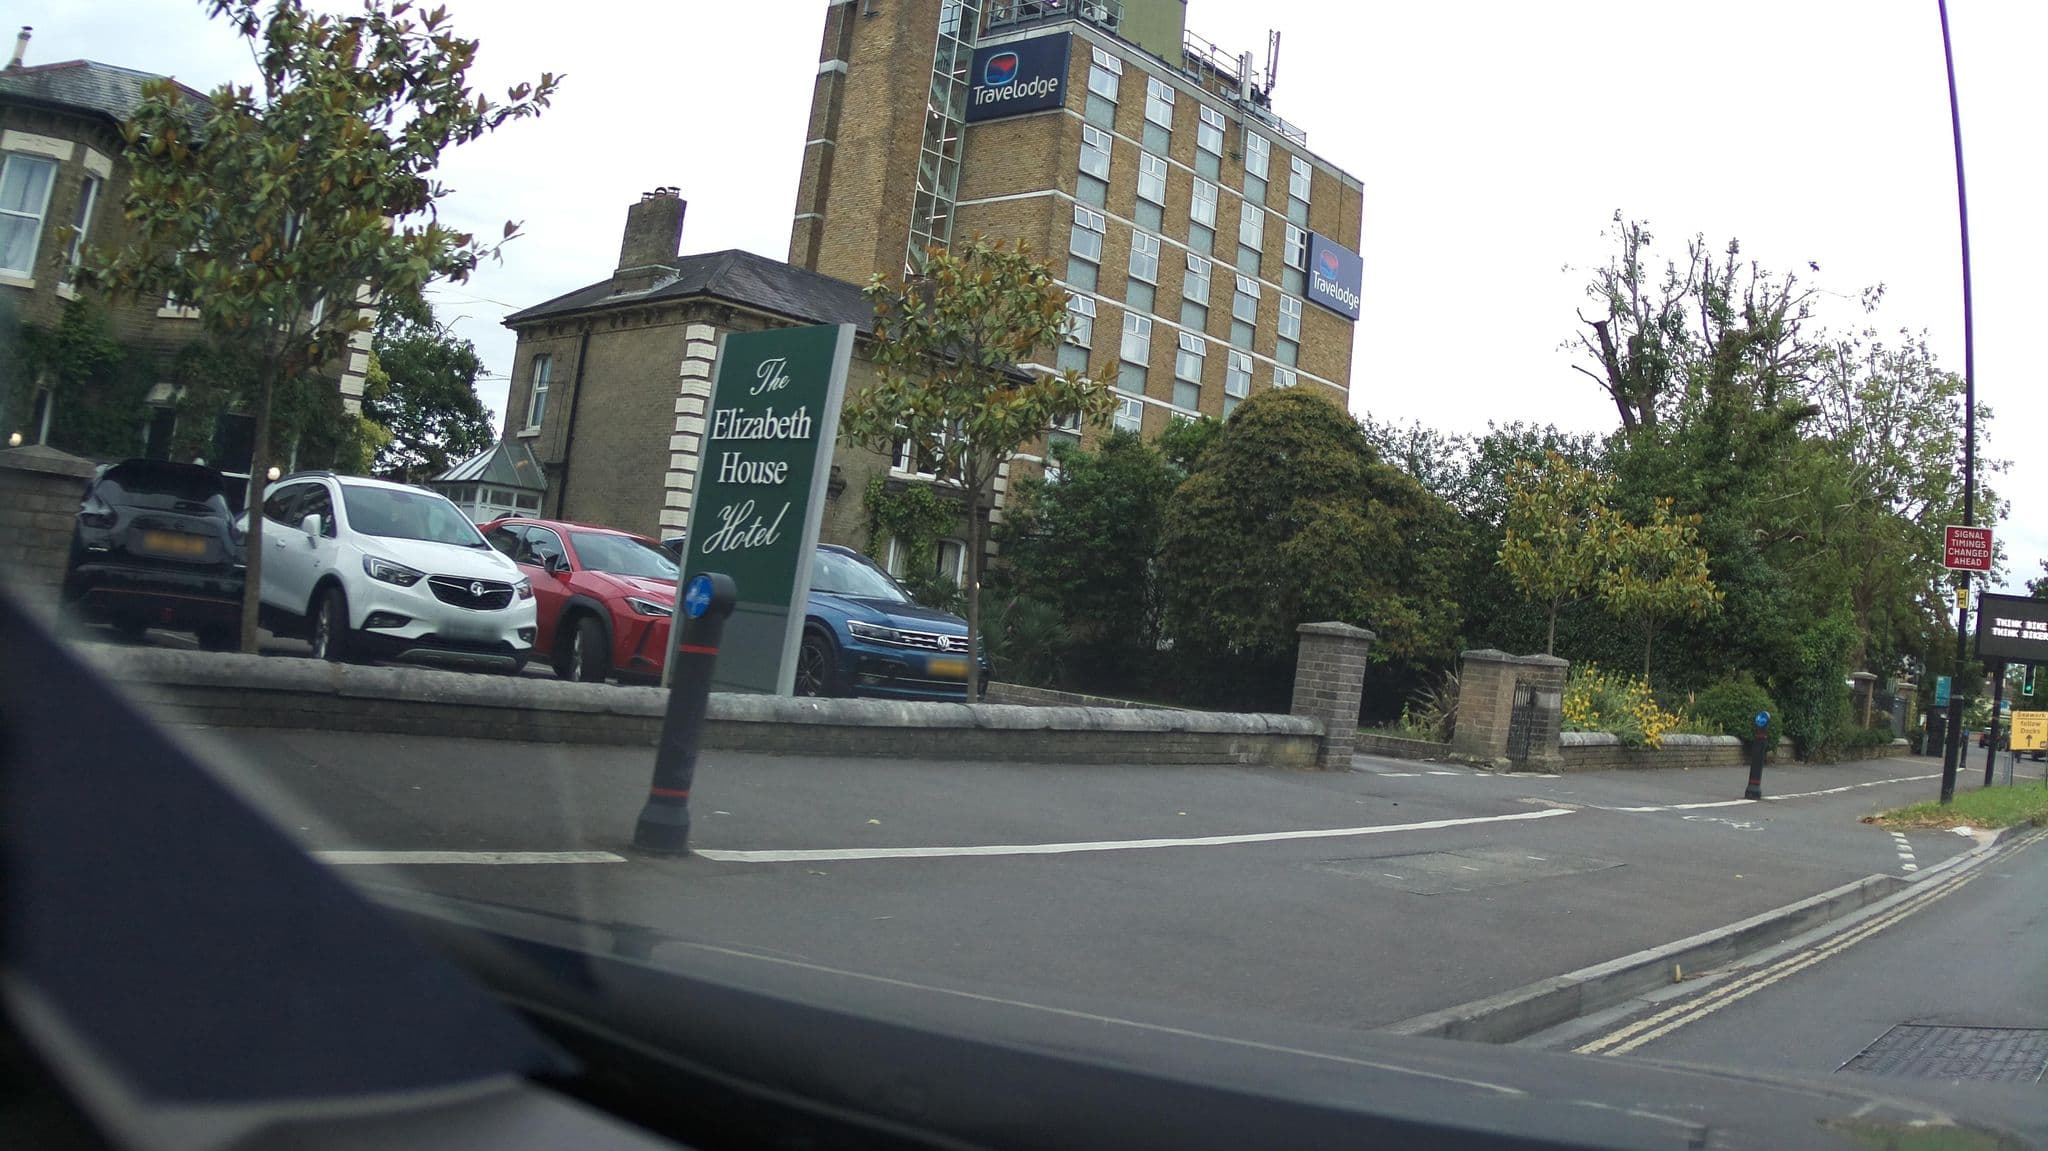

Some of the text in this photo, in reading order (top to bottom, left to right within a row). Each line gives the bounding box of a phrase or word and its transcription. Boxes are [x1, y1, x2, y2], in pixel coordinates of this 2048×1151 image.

[973, 75, 1059, 106] Travelodge
[1313, 270, 1360, 310] Travelodge
[750, 357, 791, 396] The
[711, 405, 812, 440] Elizabeth
[717, 452, 788, 485] House
[702, 499, 791, 554] Hotel
[1954, 530, 1985, 540] SIGNAL
[1948, 547, 1989, 558] CHANGED
[1951, 538, 1987, 549] TIMINGS
[1953, 557, 1982, 566] AHEAD
[2025, 620, 2048, 631] BIKE
